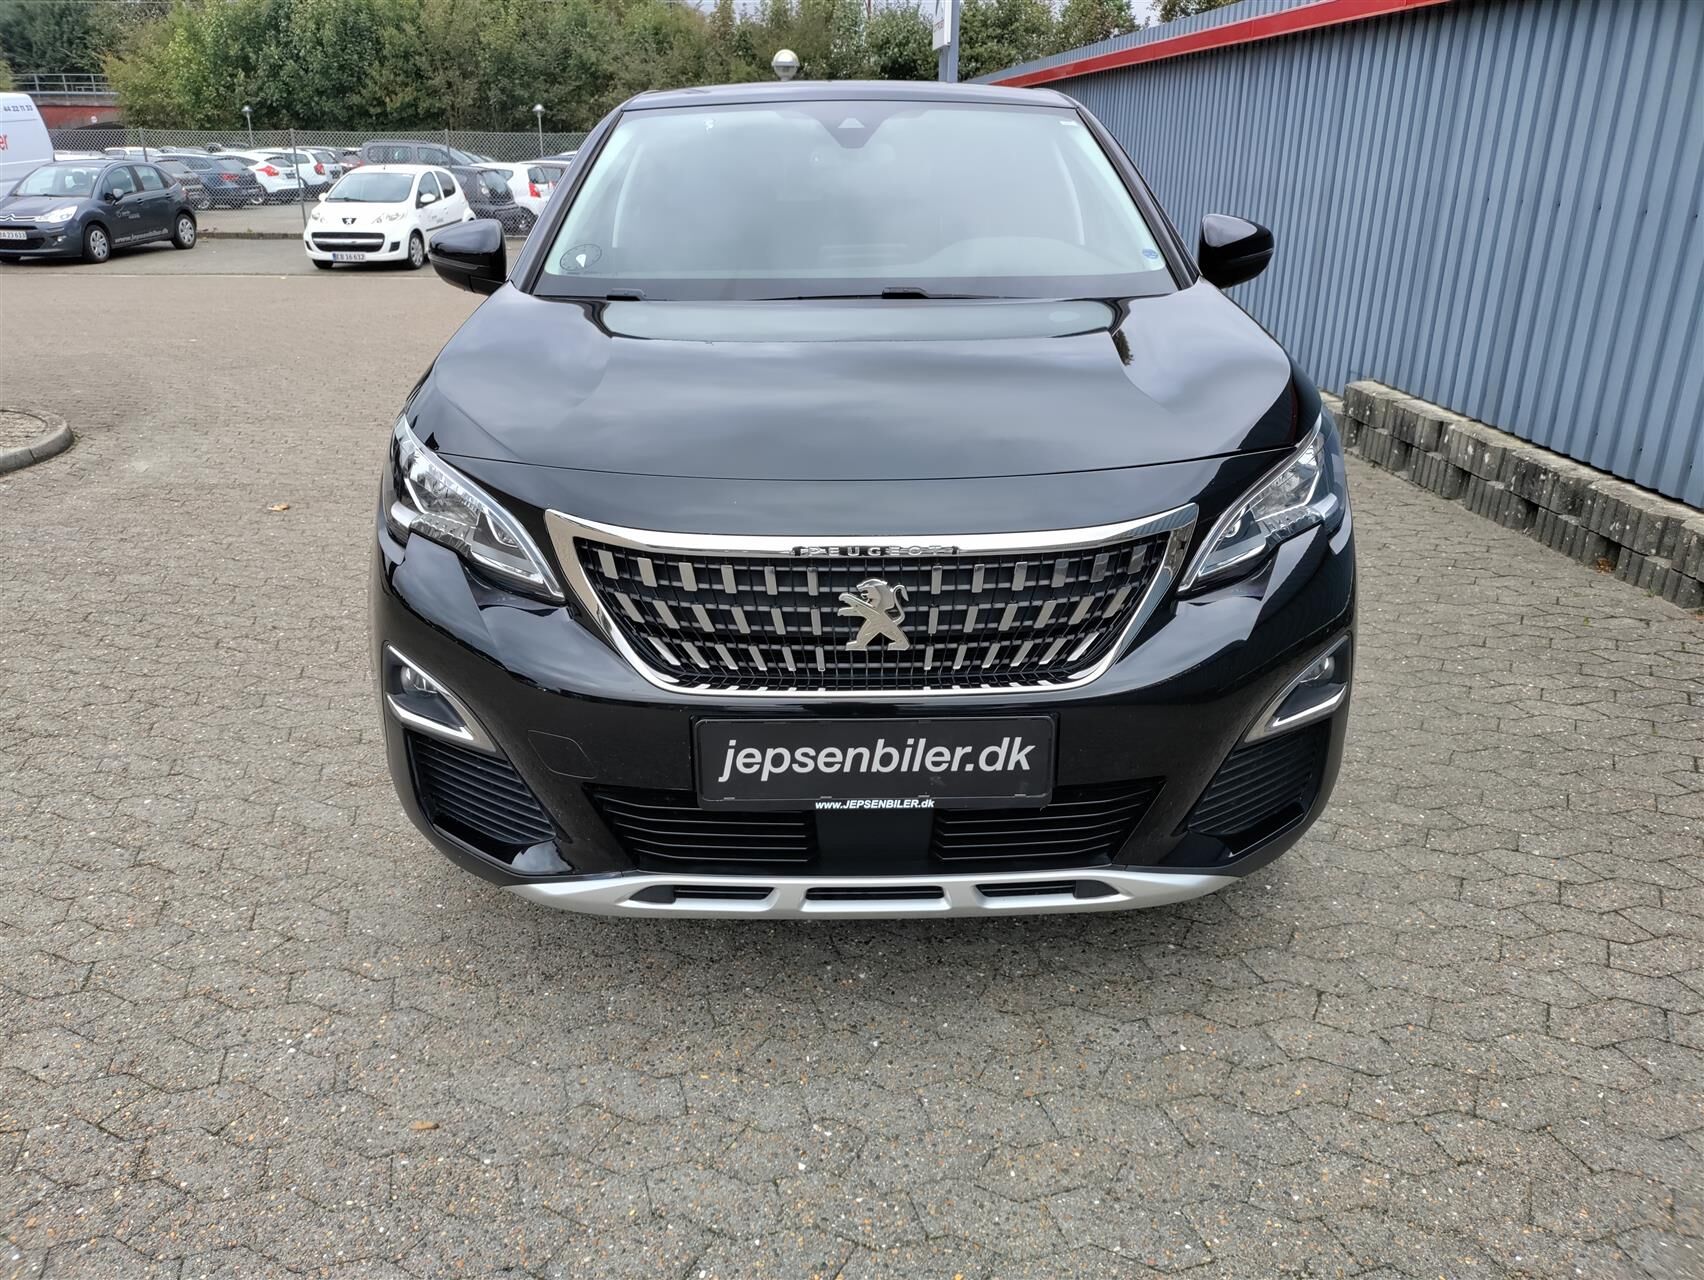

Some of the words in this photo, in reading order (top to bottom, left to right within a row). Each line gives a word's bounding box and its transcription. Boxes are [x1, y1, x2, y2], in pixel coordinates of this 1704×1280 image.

[803, 545, 943, 557] PEUGEOT
[718, 736, 1036, 783] jepsenbiler.dk
[815, 799, 935, 810] www.JEPSENBILER.dk
